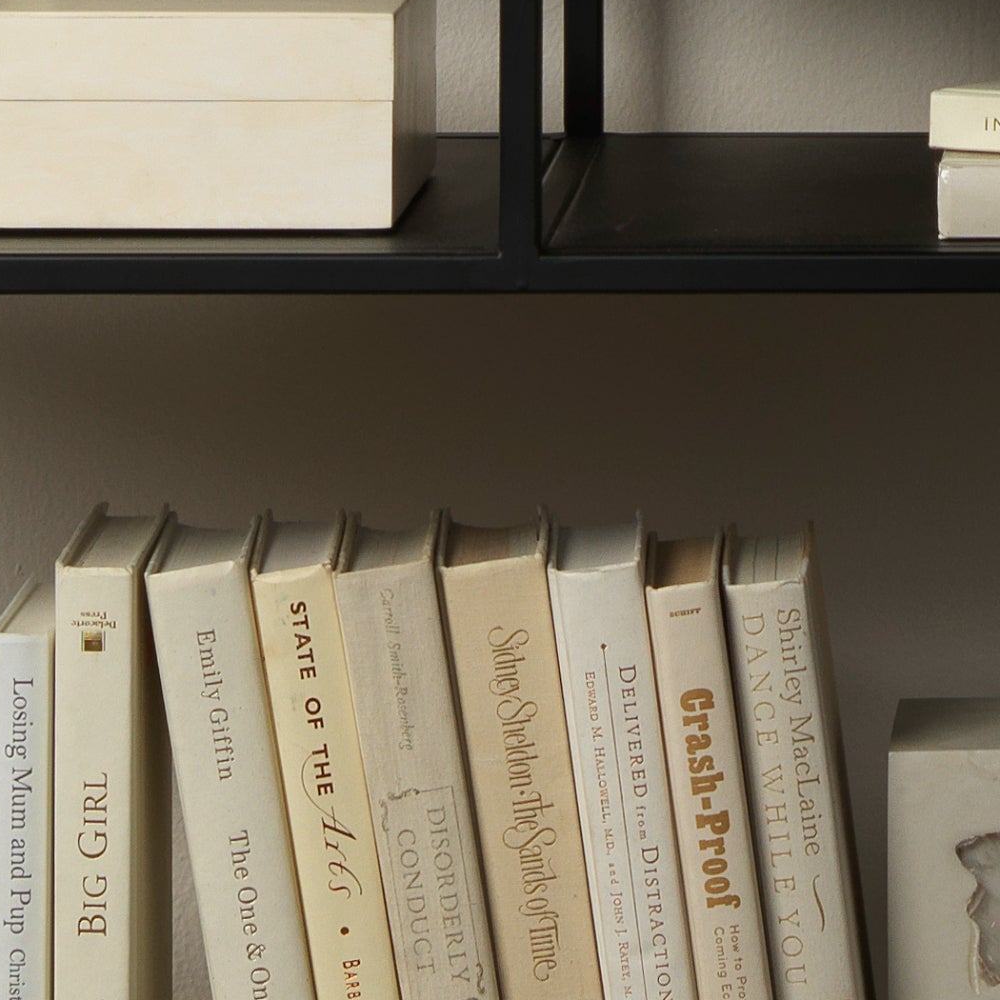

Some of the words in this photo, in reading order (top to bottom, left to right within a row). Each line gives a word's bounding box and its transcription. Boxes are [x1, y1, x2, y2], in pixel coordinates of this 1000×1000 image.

[290, 601, 317, 680] STATE
[487, 625, 530, 702] Sidney
[777, 608, 808, 705] Shirley
[197, 629, 220, 701] Emily
[209, 708, 235, 781] Giffin
[585, 671, 599, 721] EDWARD
[742, 612, 779, 747] DANCE
[4, 677, 34, 759] Losing
[305, 697, 325, 729] OF
[496, 698, 539, 790] Sheldon
[591, 726, 603, 742] M.
[312, 744, 335, 796] THE
[618, 664, 649, 798] DELIVERED
[636, 805, 647, 840] from
[10, 768, 33, 830] Mum
[77, 771, 108, 859] GIRL
[512, 791, 555, 832] The
[679, 687, 742, 909] Crash-Proof
[789, 713, 822, 857] MacLaine
[10, 839, 33, 880] and
[229, 829, 250, 880] The
[321, 806, 363, 899] Arts
[502, 827, 557, 895] Sands
[761, 764, 796, 894] WHILE
[3, 889, 32, 935] Pup
[78, 873, 107, 937] BIG
[237, 886, 259, 936] One
[396, 829, 436, 974] CONDUCT
[426, 806, 471, 982] DISORDERLY
[518, 897, 560, 917] of
[610, 890, 624, 924] JOHN
[246, 943, 266, 961] &
[528, 915, 561, 982] Time
[714, 927, 728, 979] Coming
[729, 924, 741, 952] How
[734, 957, 743, 972] to
[778, 908, 808, 985] YOU
[736, 976, 748, 1000] Pro
